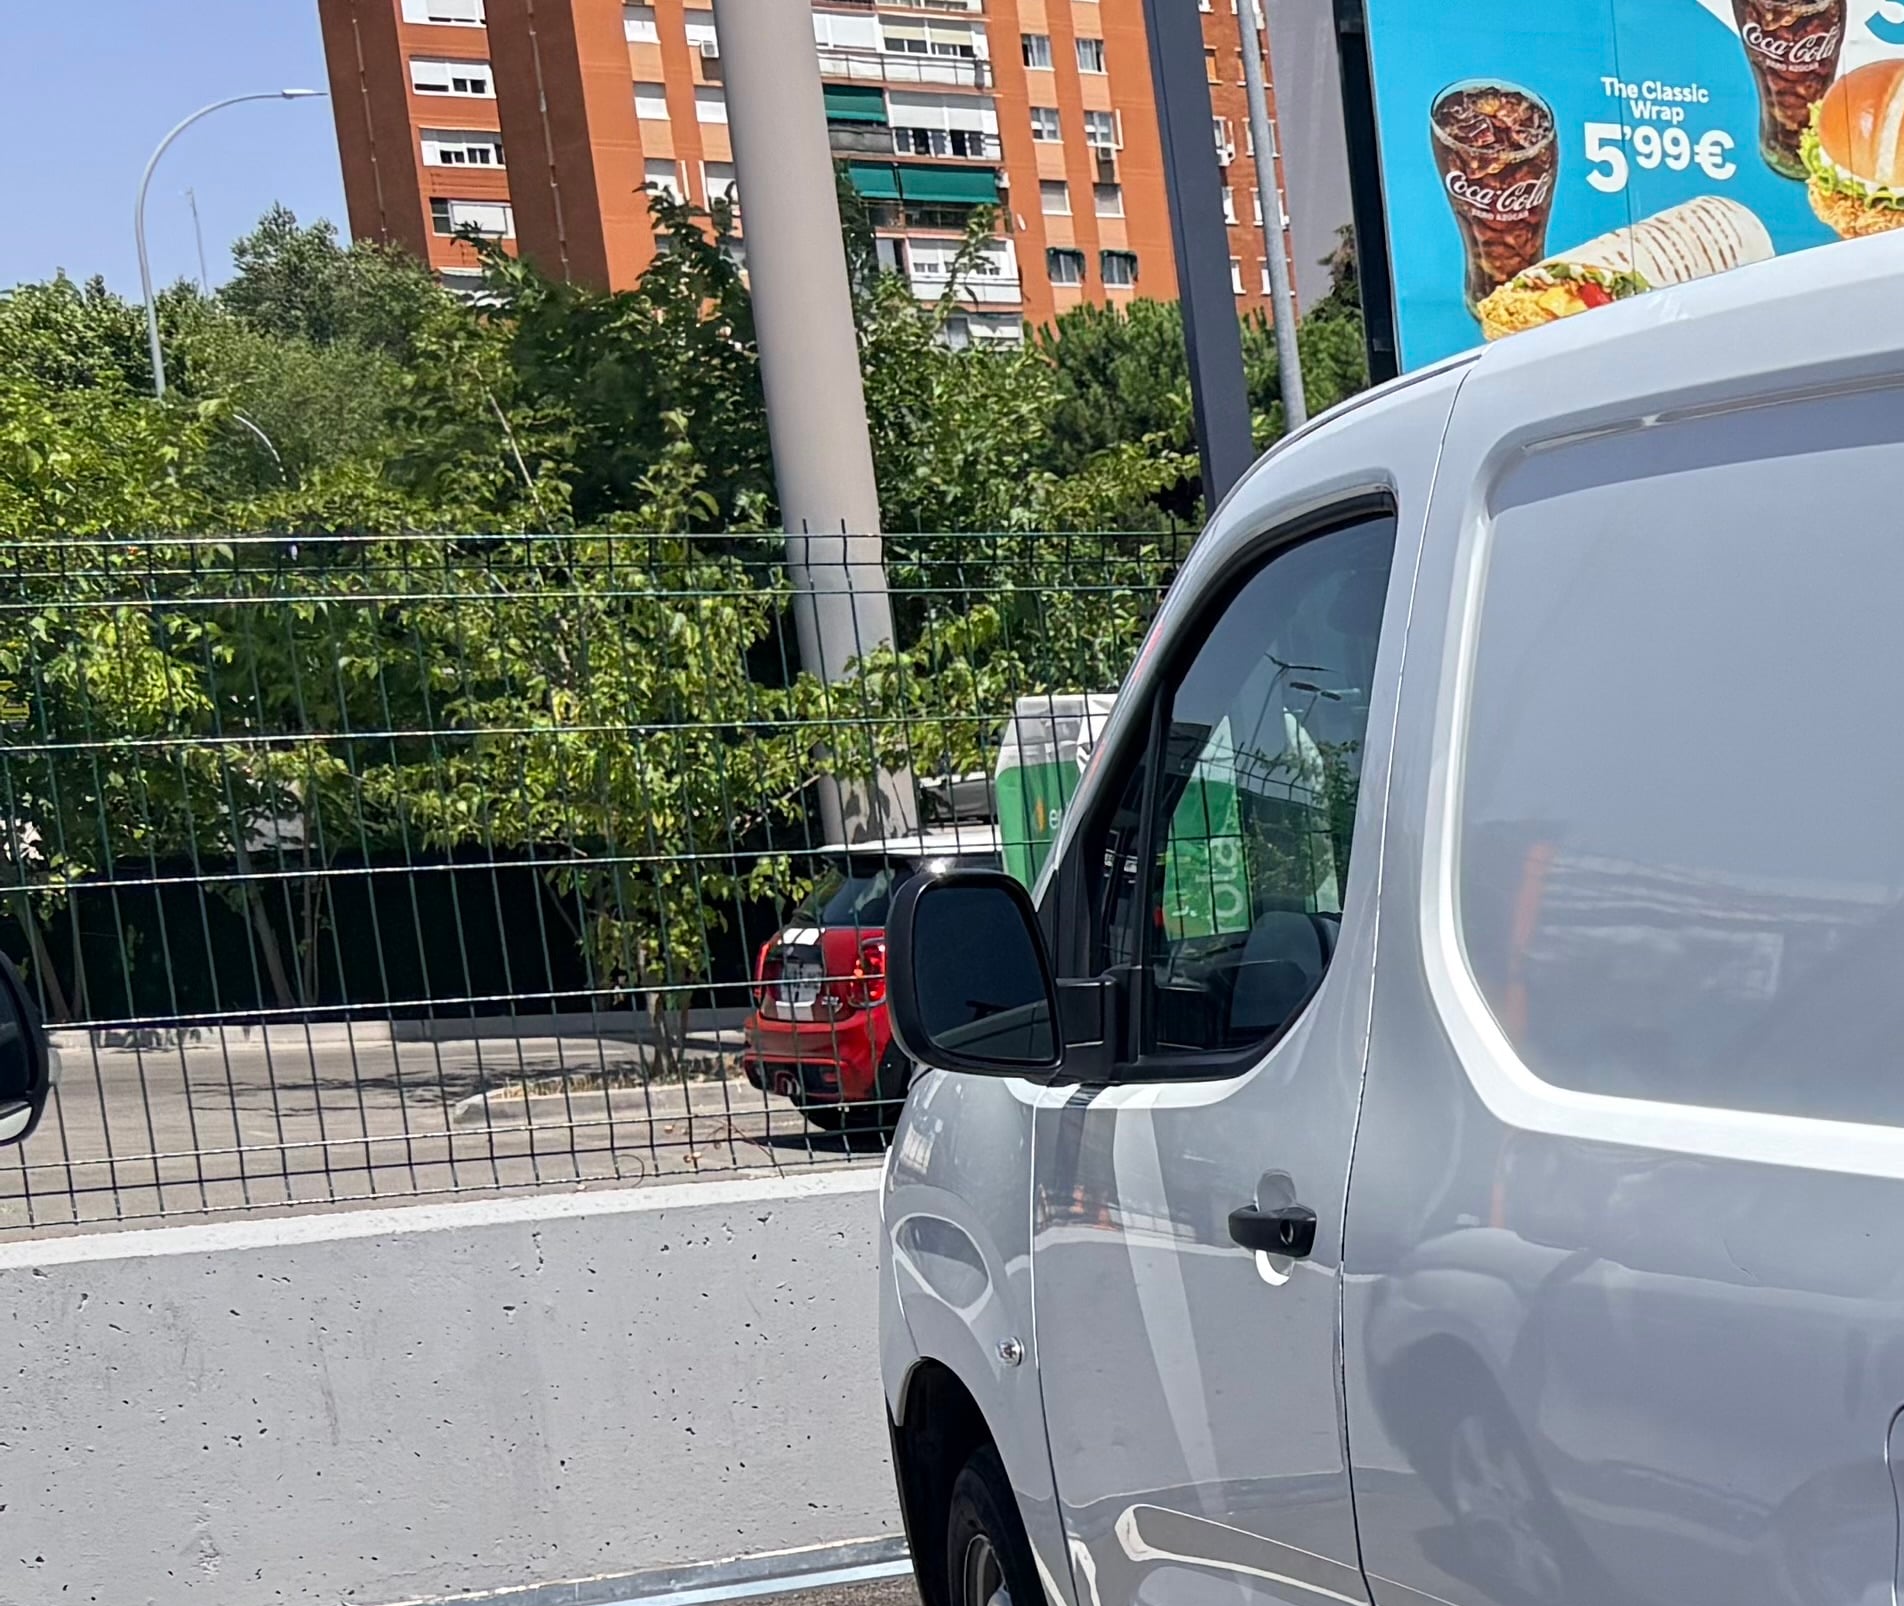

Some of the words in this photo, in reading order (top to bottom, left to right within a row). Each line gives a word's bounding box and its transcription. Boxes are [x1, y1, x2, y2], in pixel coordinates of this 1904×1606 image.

[1743, 22, 1840, 63] Coca-Cola
[1600, 77, 1638, 97] The
[1642, 81, 1709, 103] Classic
[1630, 100, 1684, 124] Wrap
[1584, 121, 1737, 193] 5'99€
[1445, 171, 1552, 212] Coca-Cola
